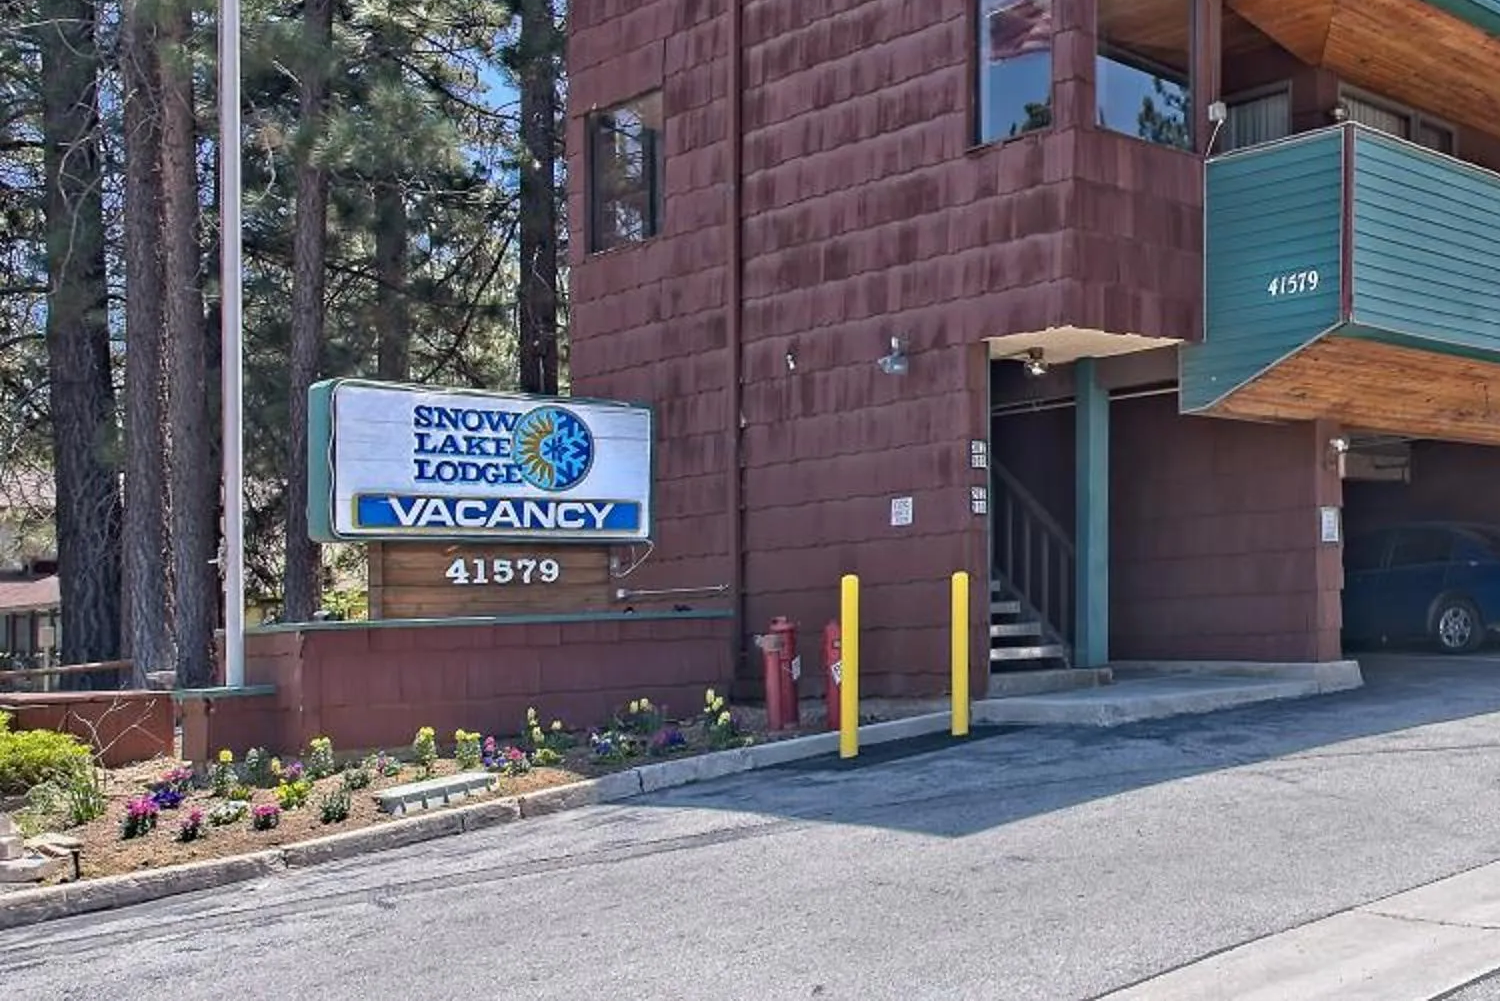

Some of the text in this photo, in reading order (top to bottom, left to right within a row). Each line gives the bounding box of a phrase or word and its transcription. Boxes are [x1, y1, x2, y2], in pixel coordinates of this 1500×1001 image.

[1267, 270, 1319, 296] 41579
[413, 404, 524, 433] SNOW
[413, 432, 513, 459] LAKE
[413, 458, 524, 485] LODGE
[386, 497, 615, 529] VACANCY
[445, 557, 560, 585] 41579
